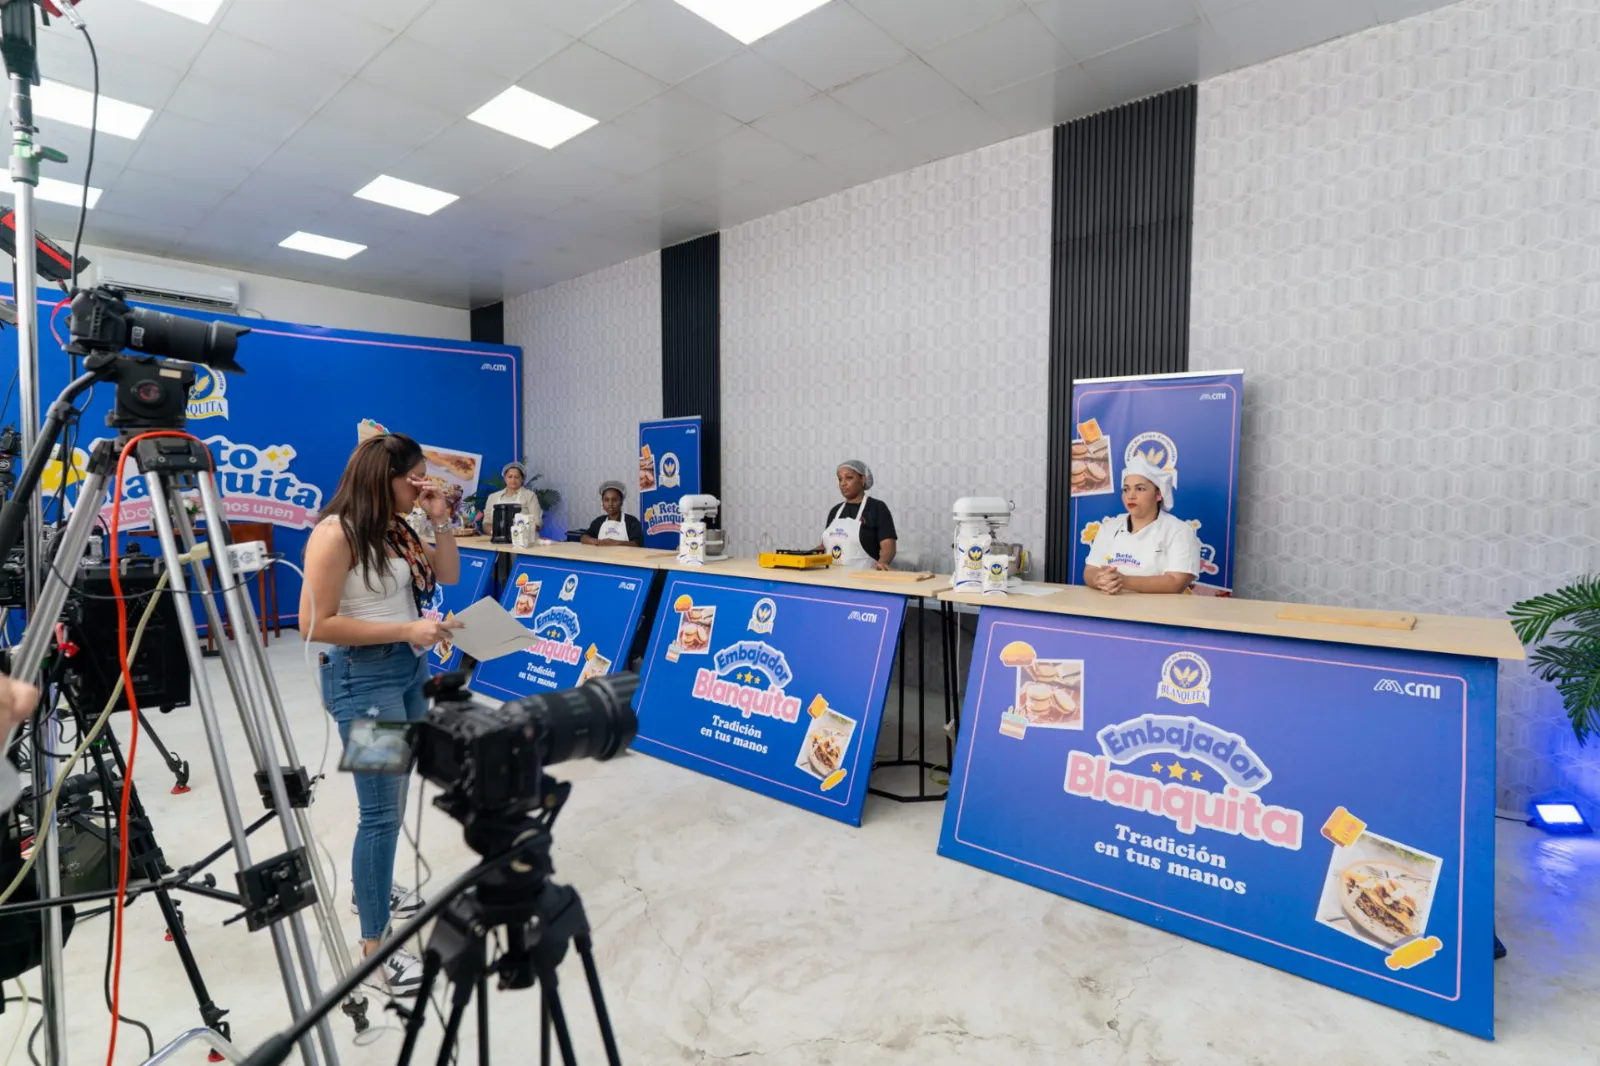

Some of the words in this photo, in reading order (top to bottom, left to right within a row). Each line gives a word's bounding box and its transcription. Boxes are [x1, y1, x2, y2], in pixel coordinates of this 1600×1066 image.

[253, 504, 294, 520] unen
[650, 513, 685, 526] Blanqui
[537, 608, 579, 636] Embajador
[861, 612, 878, 623] cmi
[527, 662, 556, 678] Tradición
[717, 644, 789, 682] Embajador
[518, 671, 527, 680] en
[536, 677, 558, 689] manos
[1161, 683, 1207, 702] BLANQUITA
[1404, 682, 1440, 700] cmi
[692, 669, 801, 723] Blanquita
[712, 715, 762, 739] Tradición
[700, 727, 713, 738] en
[714, 730, 732, 743] tus
[732, 736, 769, 754] manos
[1102, 720, 1265, 782] Embajador
[1065, 752, 1302, 849] Blanquita
[1115, 823, 1227, 868] Tradición
[1094, 840, 1120, 858] en
[1126, 847, 1162, 870] tus
[1166, 861, 1248, 895] manos
